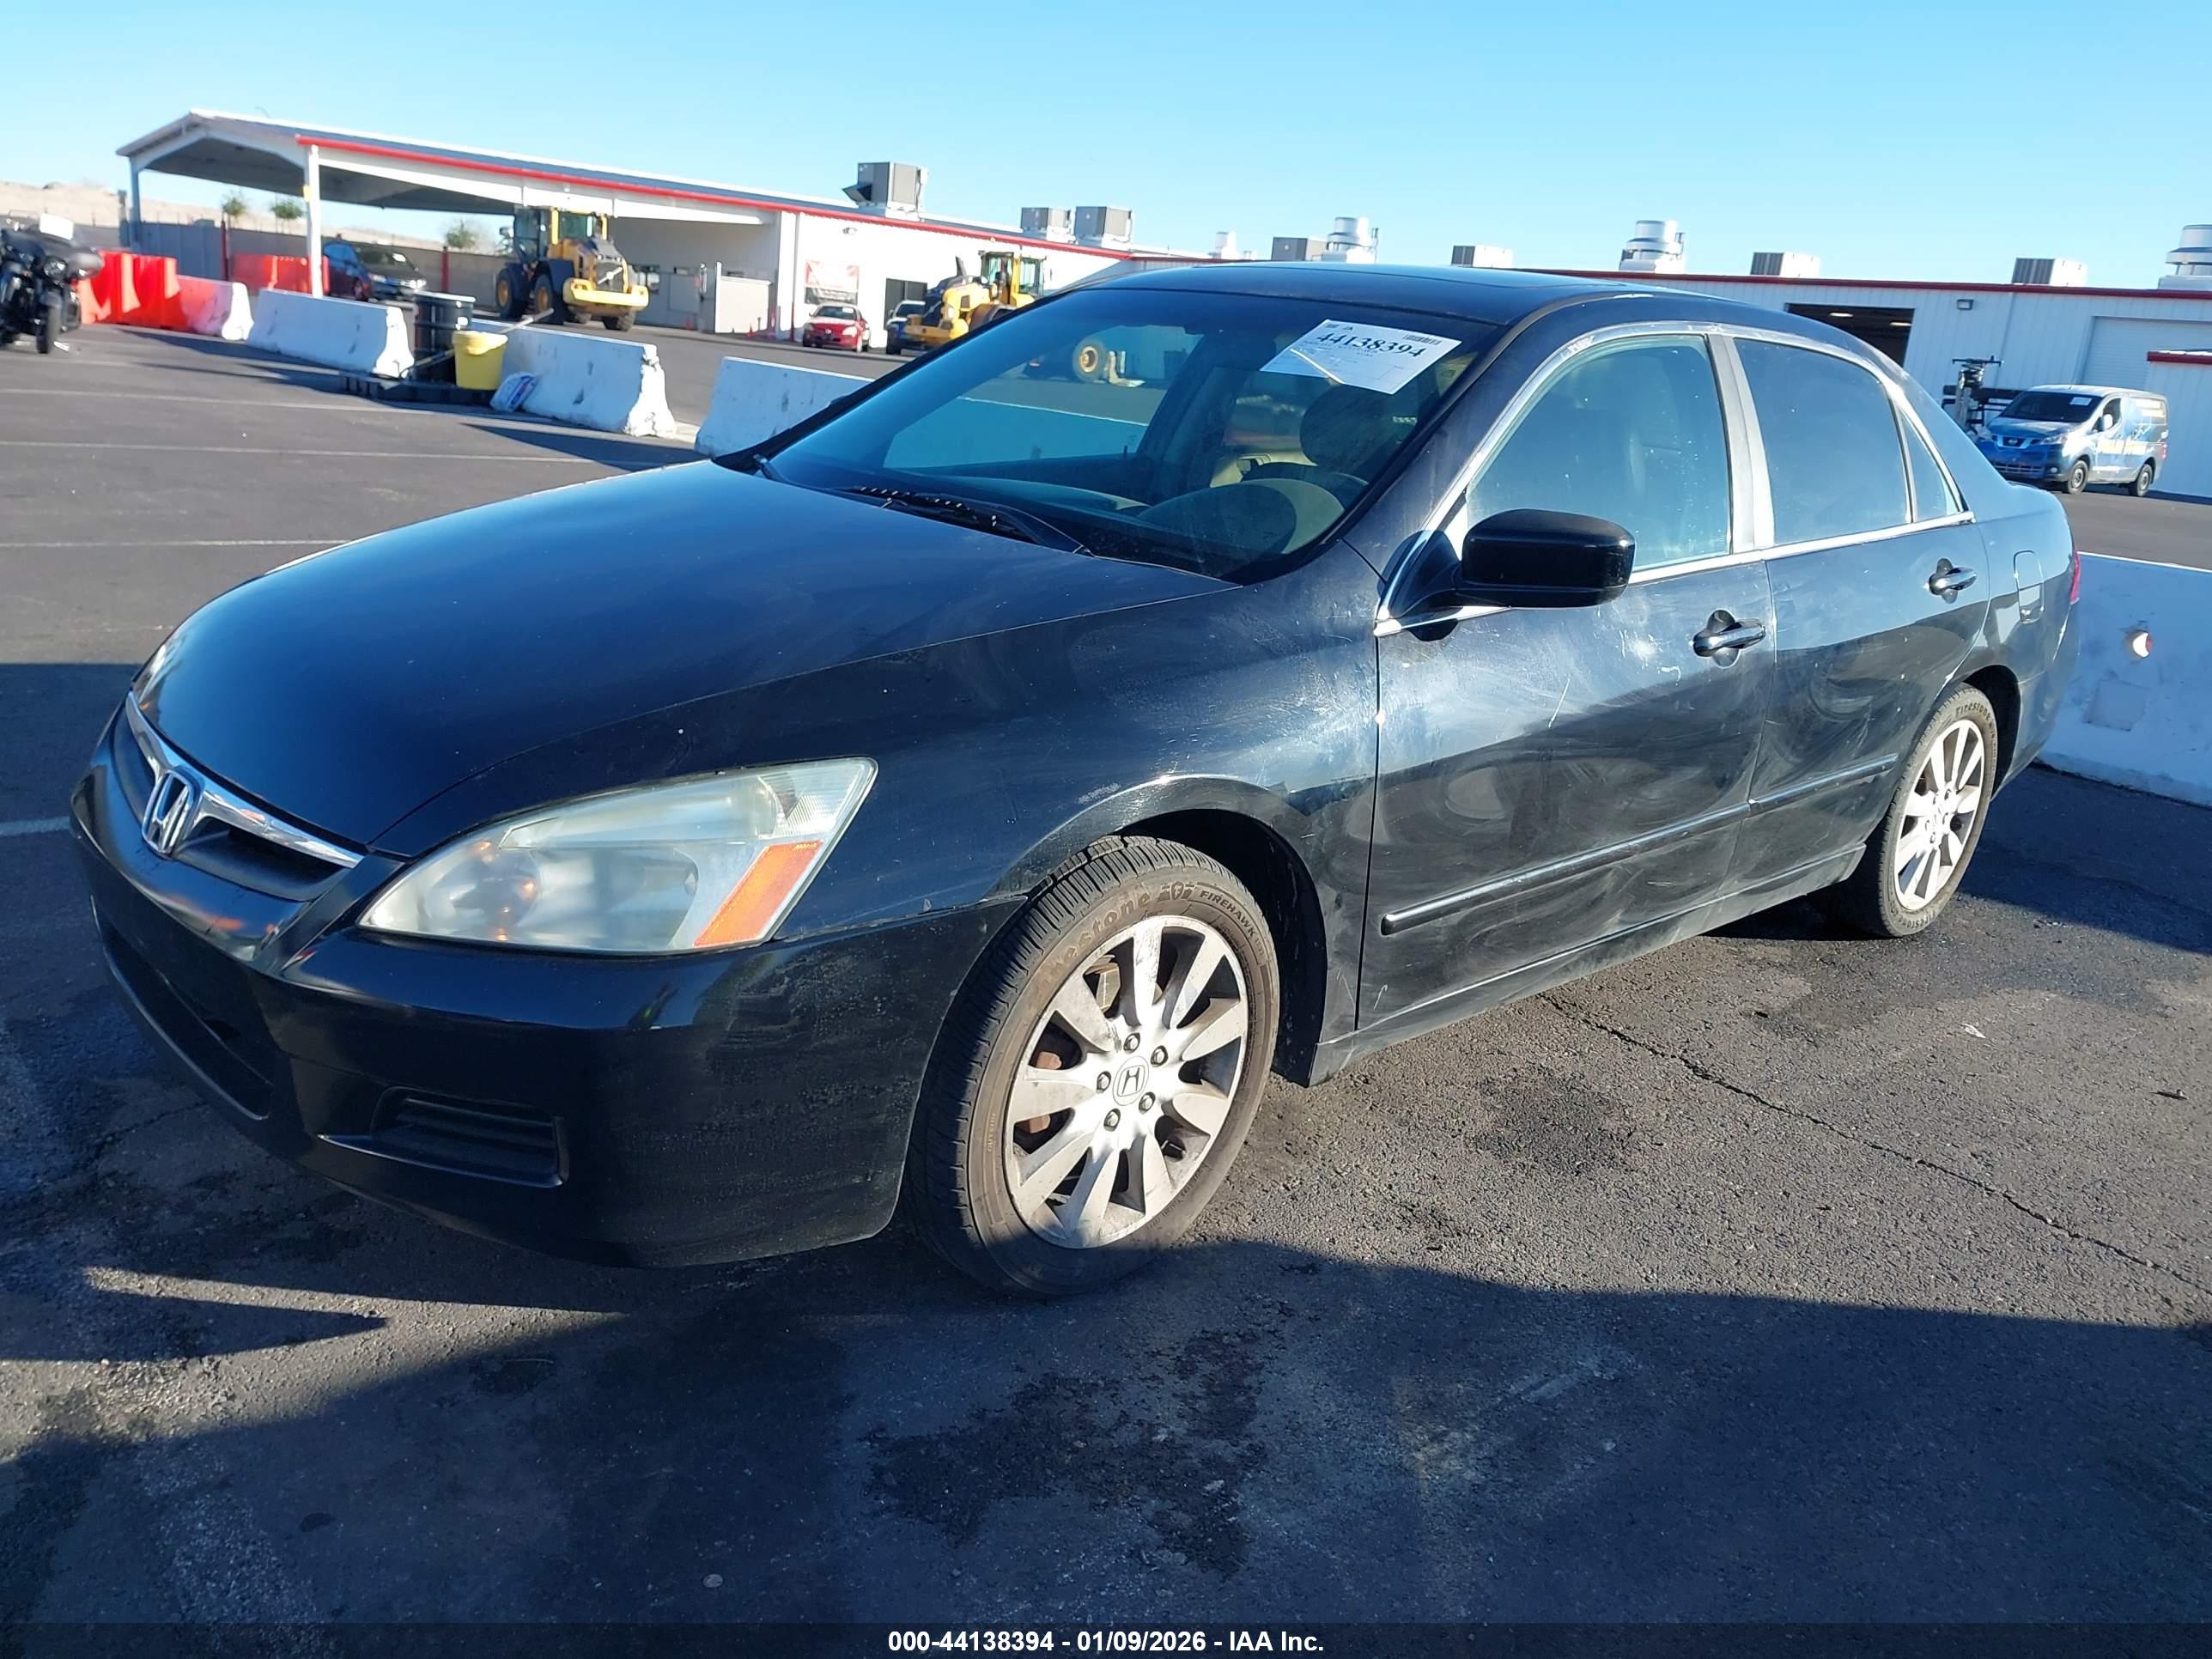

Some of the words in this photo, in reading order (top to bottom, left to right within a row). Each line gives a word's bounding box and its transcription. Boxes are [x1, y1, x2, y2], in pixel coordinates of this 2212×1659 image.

[1316, 332, 1427, 358] 44138394
[1955, 702, 1990, 720] Firestone
[1199, 890, 1256, 937] FIREHAWK
[1042, 891, 1151, 984] restone
